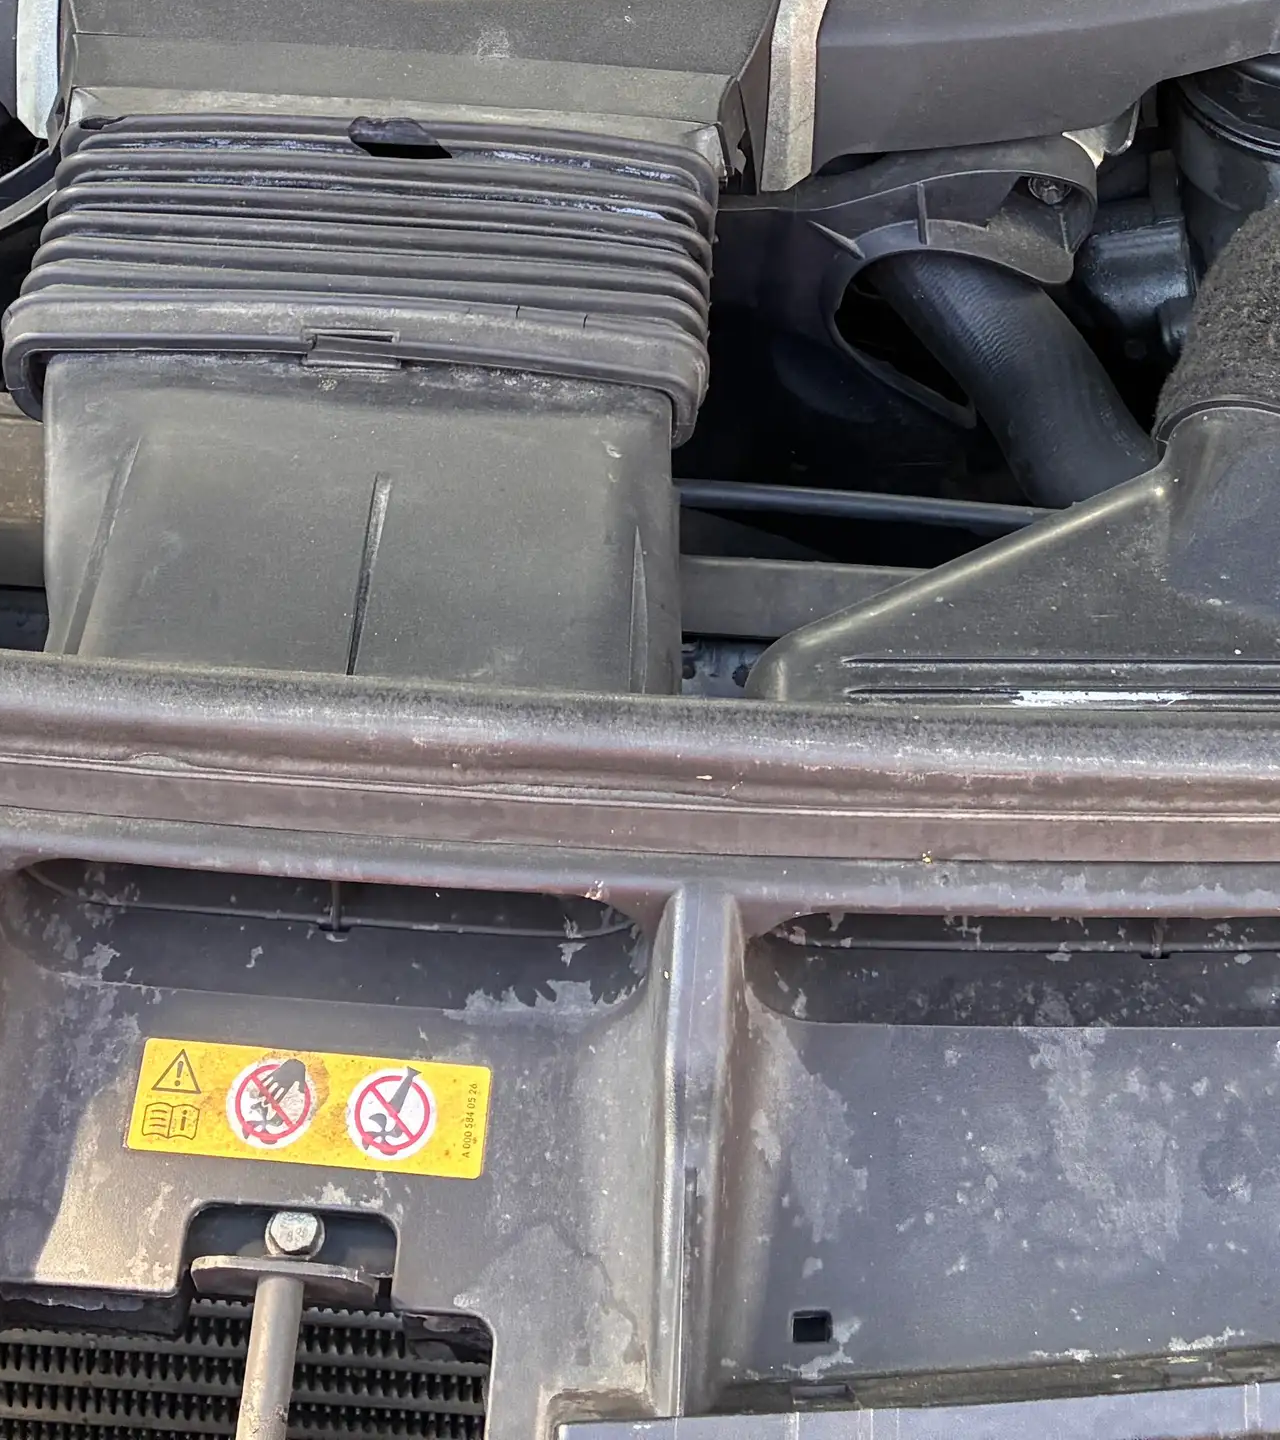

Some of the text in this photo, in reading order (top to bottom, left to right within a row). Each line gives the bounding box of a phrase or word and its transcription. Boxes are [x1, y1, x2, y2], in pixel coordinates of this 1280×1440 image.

[467, 1083, 478, 1094] 26
[466, 1097, 476, 1108] 05
[463, 1112, 475, 1128] 584
[461, 1131, 473, 1148] 000
